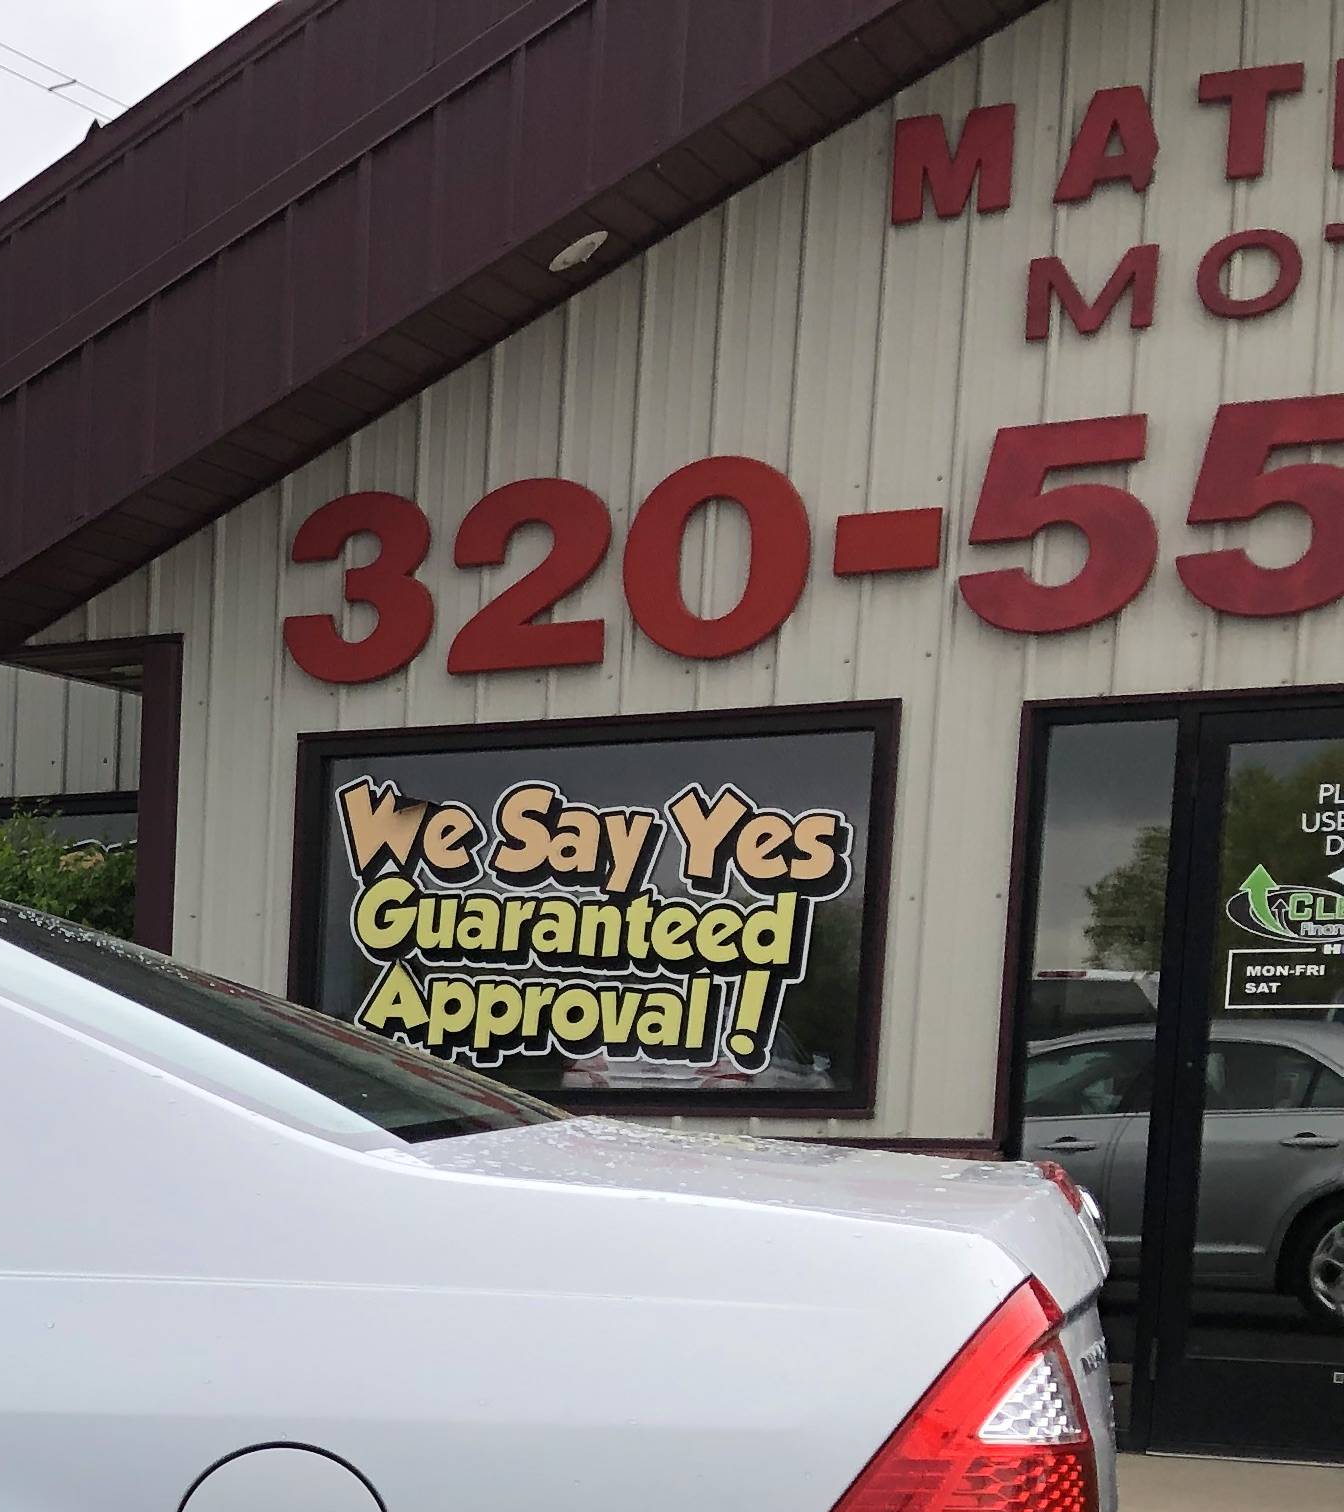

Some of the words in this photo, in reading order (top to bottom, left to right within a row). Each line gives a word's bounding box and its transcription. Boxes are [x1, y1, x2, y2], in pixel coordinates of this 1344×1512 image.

[891, 58, 1344, 226] MAT
[1025, 222, 1344, 341] MO
[283, 393, 1344, 684] 320-55
[336, 776, 480, 874] We
[492, 784, 658, 894] Say
[666, 789, 842, 884] Yes
[353, 875, 802, 968] Guaranteed
[1246, 964, 1326, 977] MON-FRI
[360, 960, 772, 1057] Approval!
[1244, 982, 1281, 994] SAT
